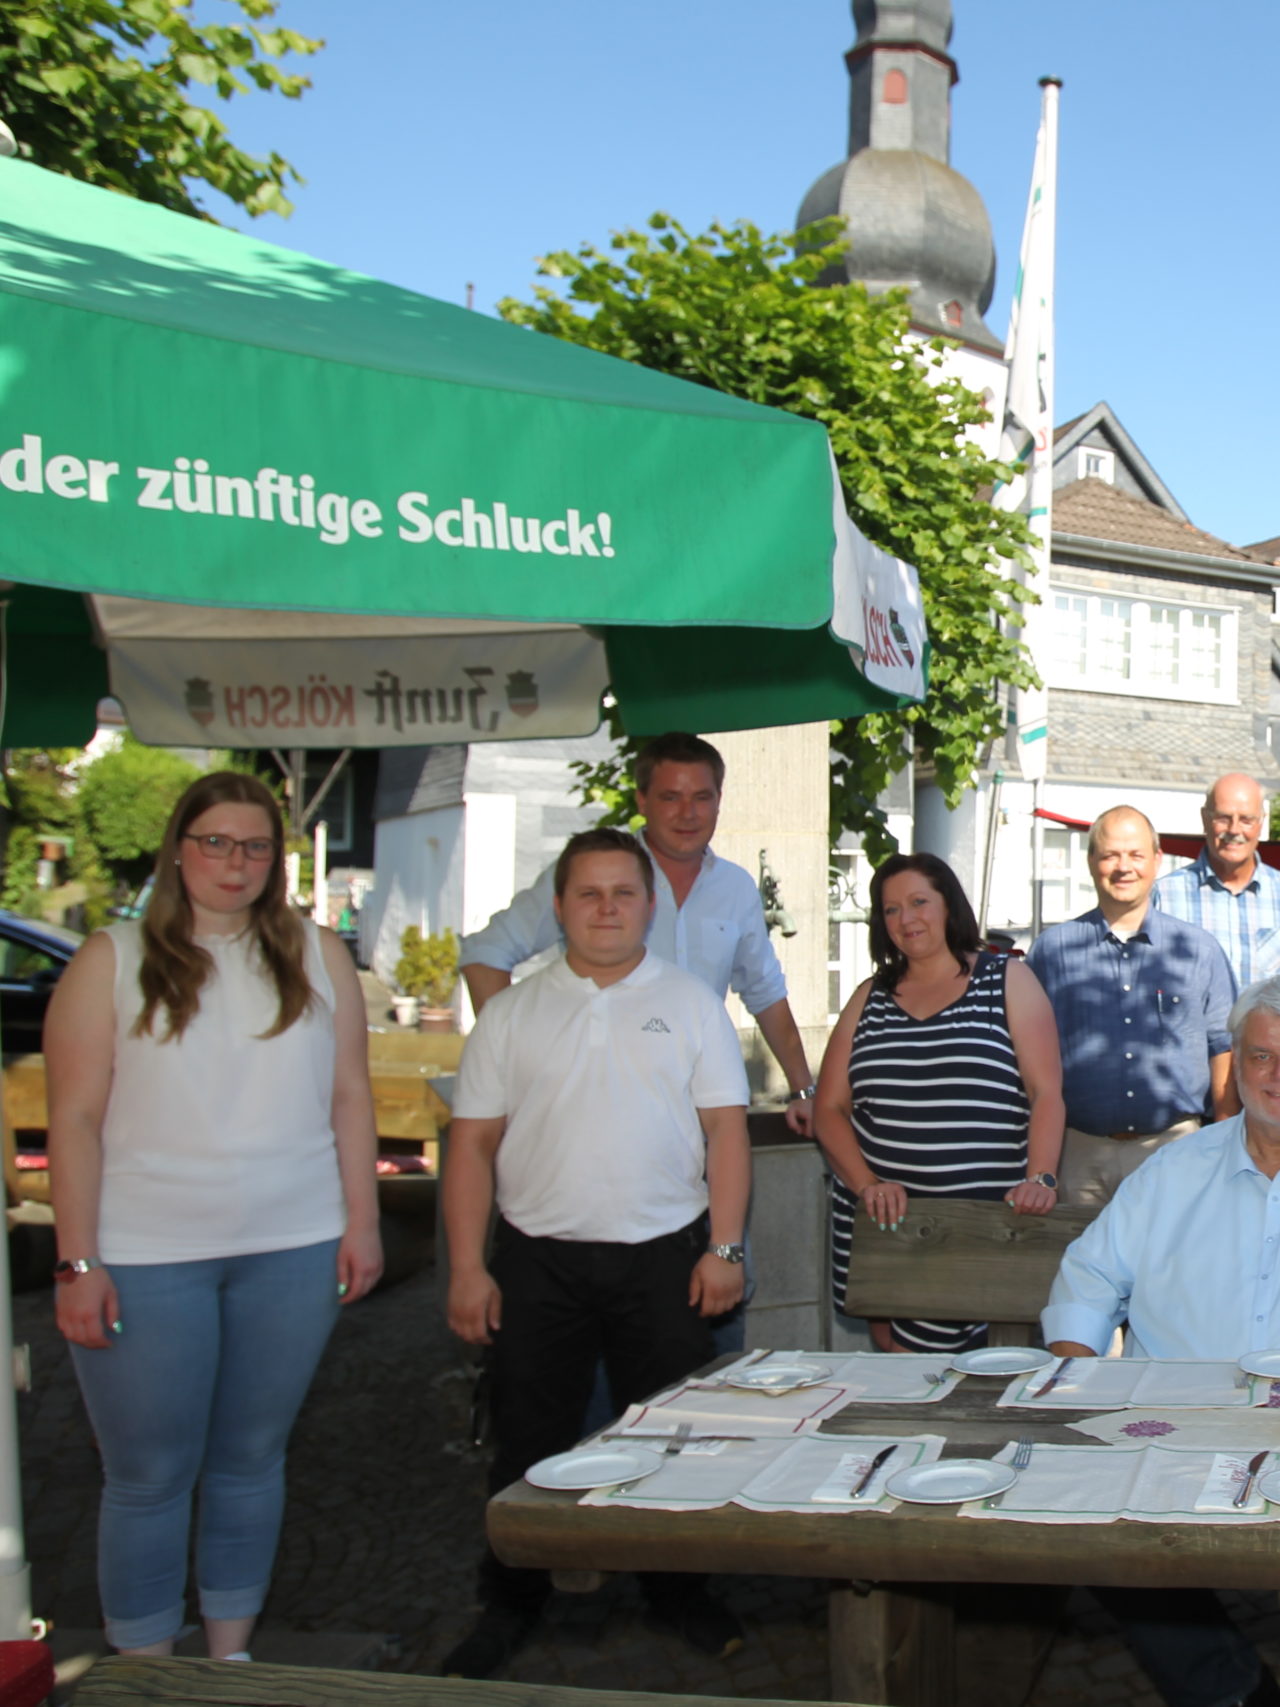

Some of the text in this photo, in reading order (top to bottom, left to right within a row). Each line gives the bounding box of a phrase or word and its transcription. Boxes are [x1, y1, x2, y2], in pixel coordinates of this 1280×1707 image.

[0, 433, 616, 558] der zünftige Schluck!
